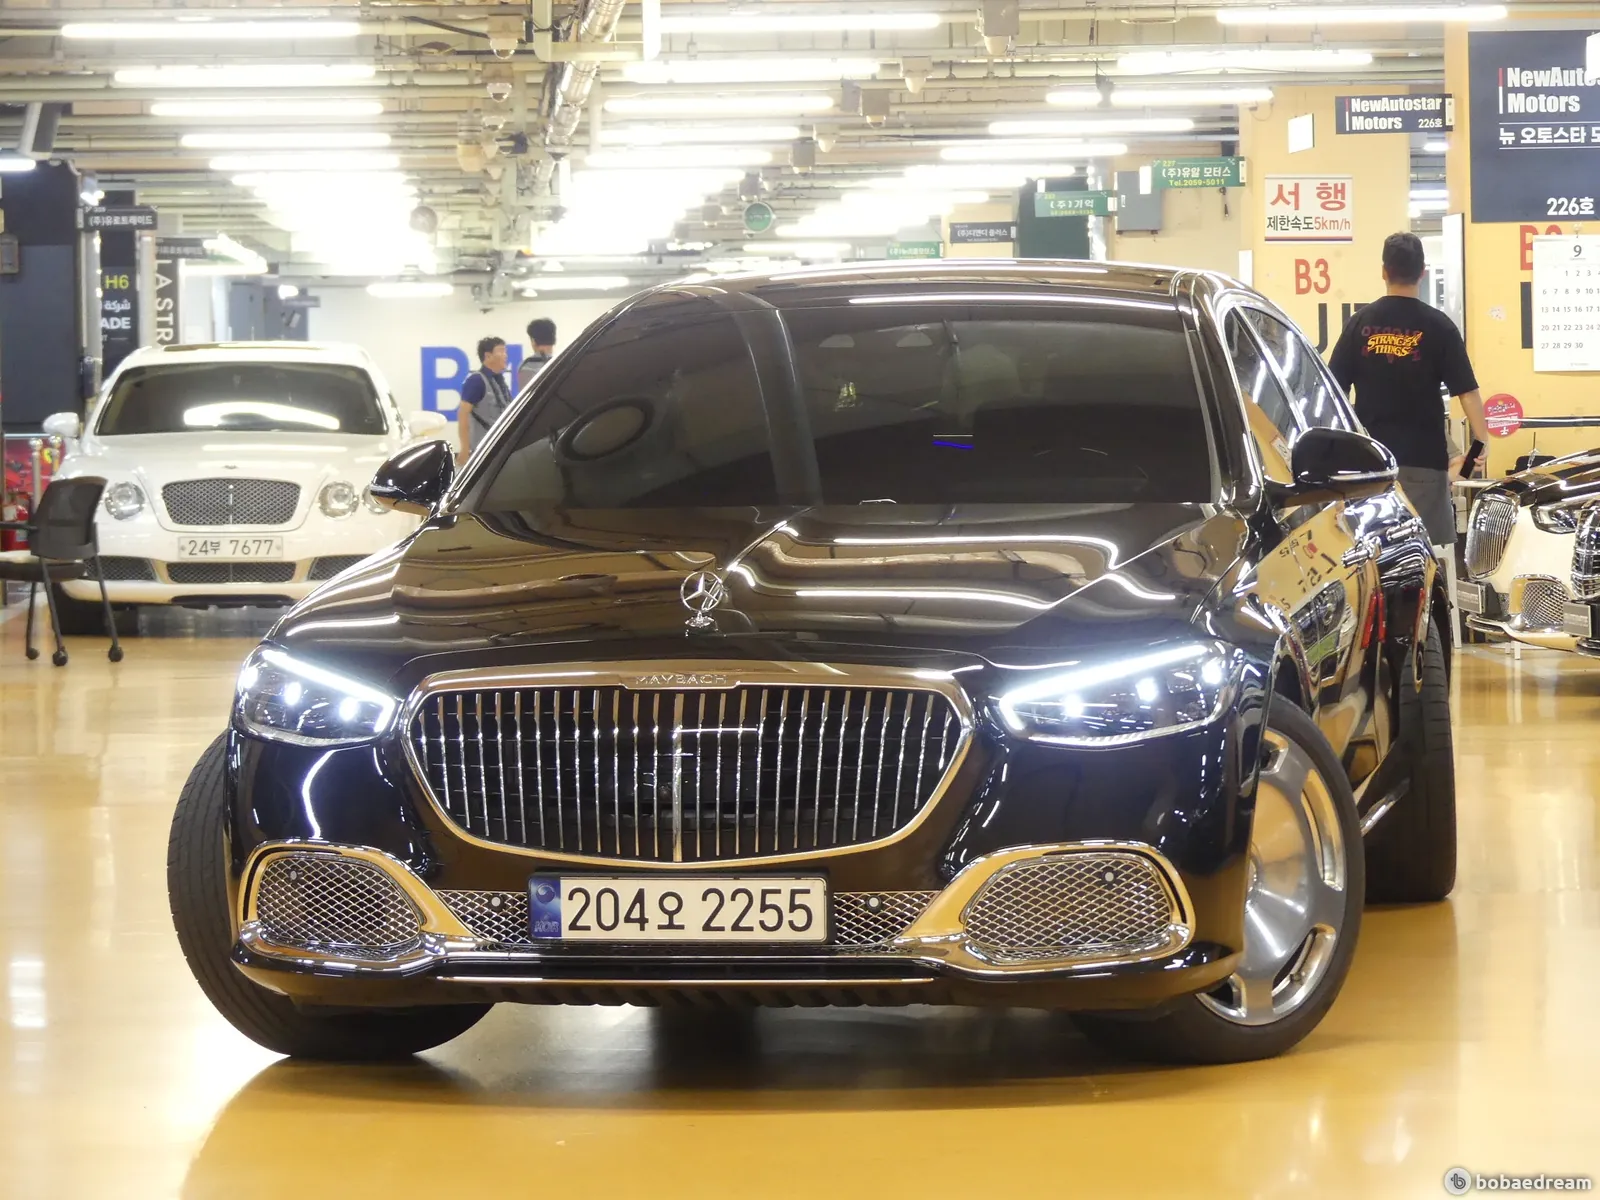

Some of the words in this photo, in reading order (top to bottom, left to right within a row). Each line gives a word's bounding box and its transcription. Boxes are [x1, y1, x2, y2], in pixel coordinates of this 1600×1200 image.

[1507, 66, 1600, 88] NewAut
[1351, 97, 1442, 113] NewAutostar
[1507, 93, 1581, 113] Motors
[1351, 116, 1403, 131] Motors
[1418, 118, 1443, 129] 226호
[1499, 127, 1516, 145] 뉴
[1520, 126, 1587, 144] 오토스타
[1203, 166, 1232, 177] 모터스
[1546, 196, 1596, 216] 226호
[1573, 244, 1582, 258] 9
[1294, 257, 1332, 296] B3
[1575, 269, 1581, 277] 2
[1587, 269, 1592, 277] 3
[104, 274, 130, 290] H6
[1575, 287, 1581, 295] 9
[1585, 287, 1594, 295] 10
[1541, 306, 1549, 314] 13
[1552, 306, 1561, 314] 14
[1585, 305, 1594, 313] 17
[1541, 324, 1550, 332] 20
[1552, 324, 1561, 332] 21
[1367, 331, 1423, 353] STRANGER
[1541, 342, 1550, 350] 27
[1552, 342, 1561, 350] 28
[1375, 344, 1413, 357] THINGS
[229, 539, 274, 556] 7677
[635, 673, 728, 685] MAYBACH
[567, 886, 686, 932] 204오
[700, 886, 814, 932] 2255
[534, 920, 560, 933] KOR
